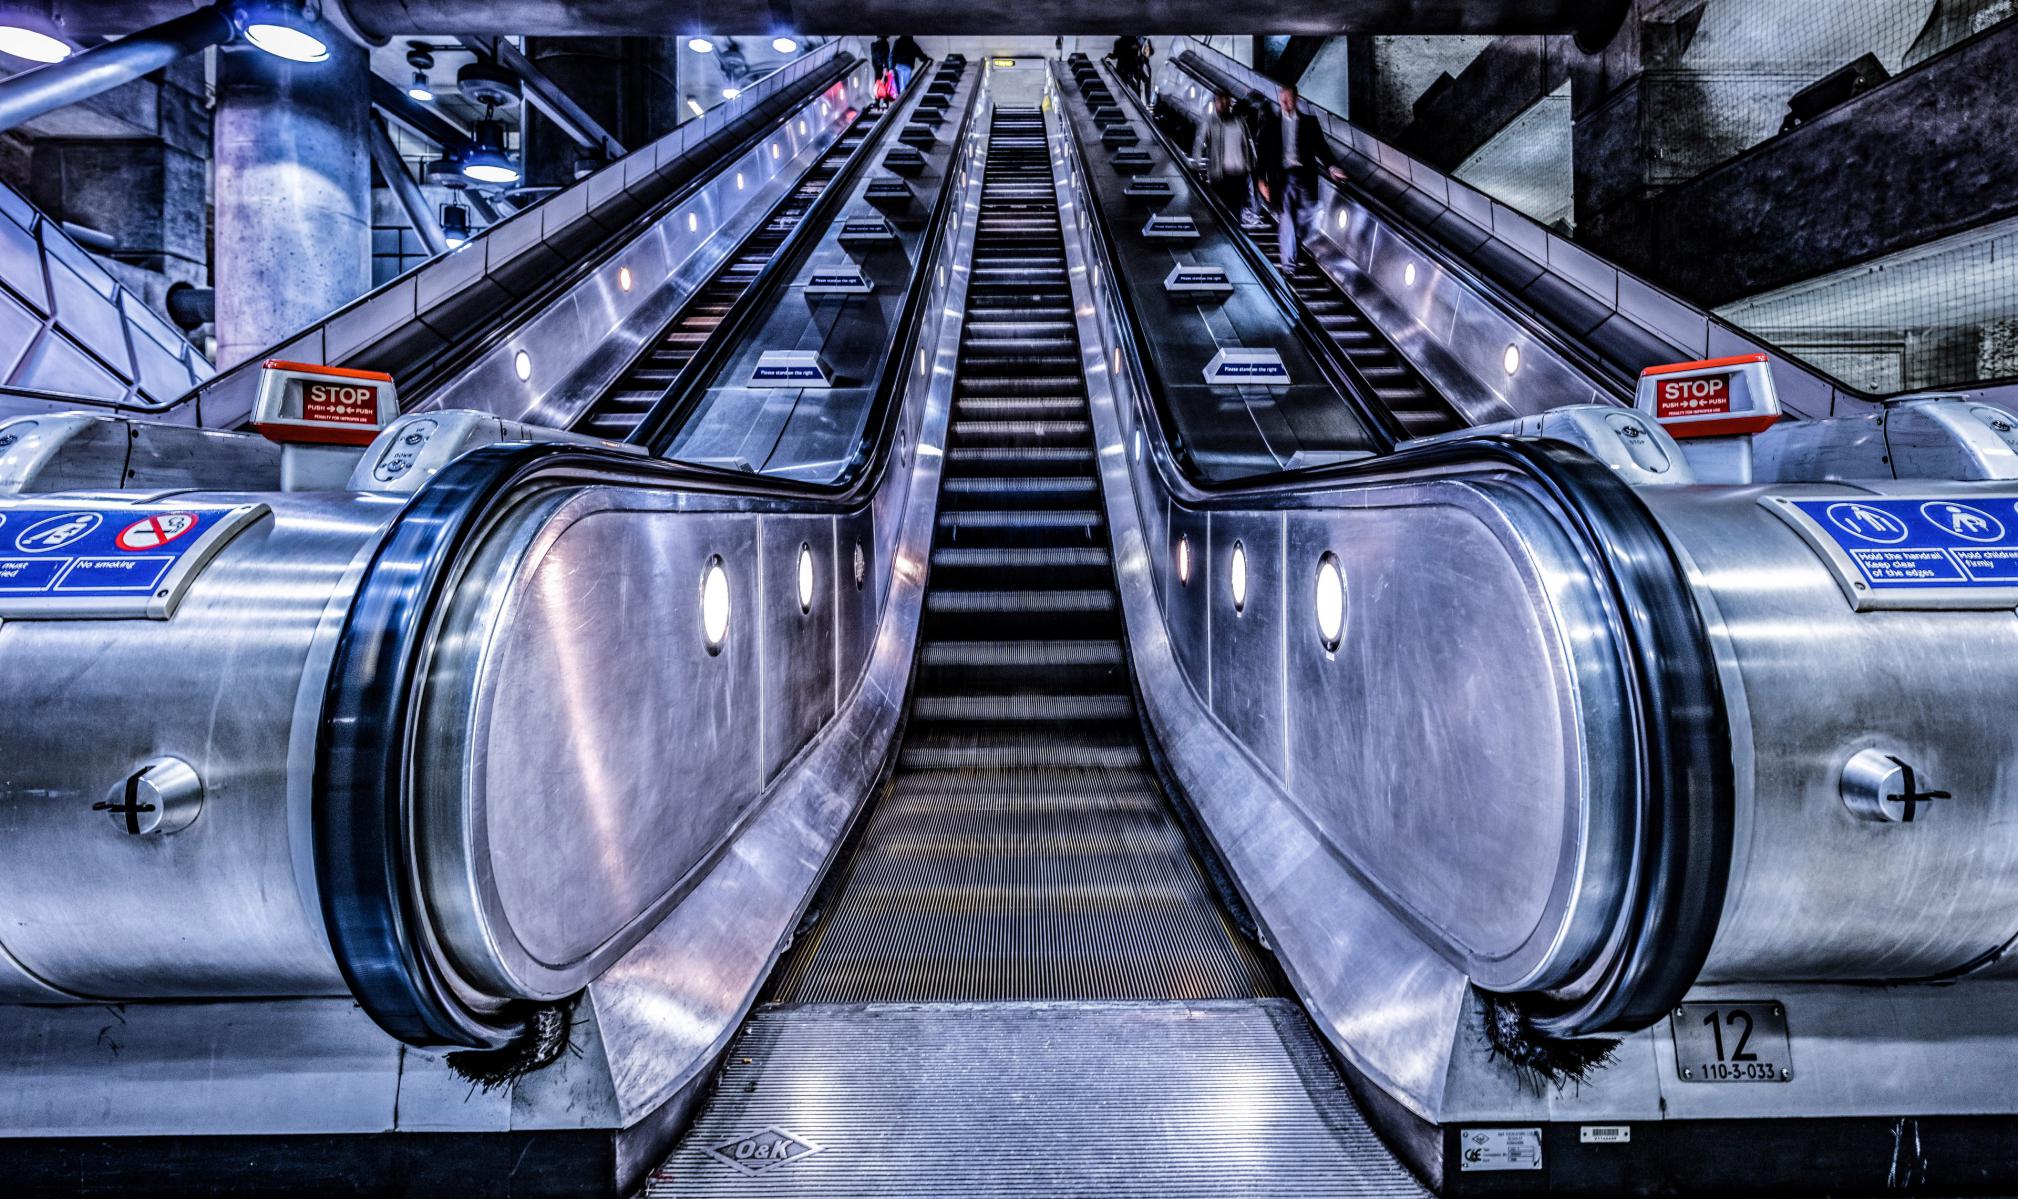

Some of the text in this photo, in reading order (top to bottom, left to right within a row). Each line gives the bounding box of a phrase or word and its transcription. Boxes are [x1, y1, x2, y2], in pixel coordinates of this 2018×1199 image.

[1665, 379, 1723, 400] STOP
[311, 384, 371, 406] STOP
[307, 404, 373, 415] PUSH PUSH
[1858, 552, 1884, 561] Hold
[1884, 552, 1903, 560] the
[1957, 551, 1983, 560] Hold
[1, 562, 29, 570] must
[76, 560, 136, 570] No smoking
[1864, 560, 1916, 569] Keep clear
[1965, 559, 1995, 569] firmly
[1872, 569, 1936, 578] of the edges
[1703, 1008, 1758, 1062] 12
[1702, 1063, 1775, 1079] 110-3-033
[735, 1139, 794, 1159] O&K
